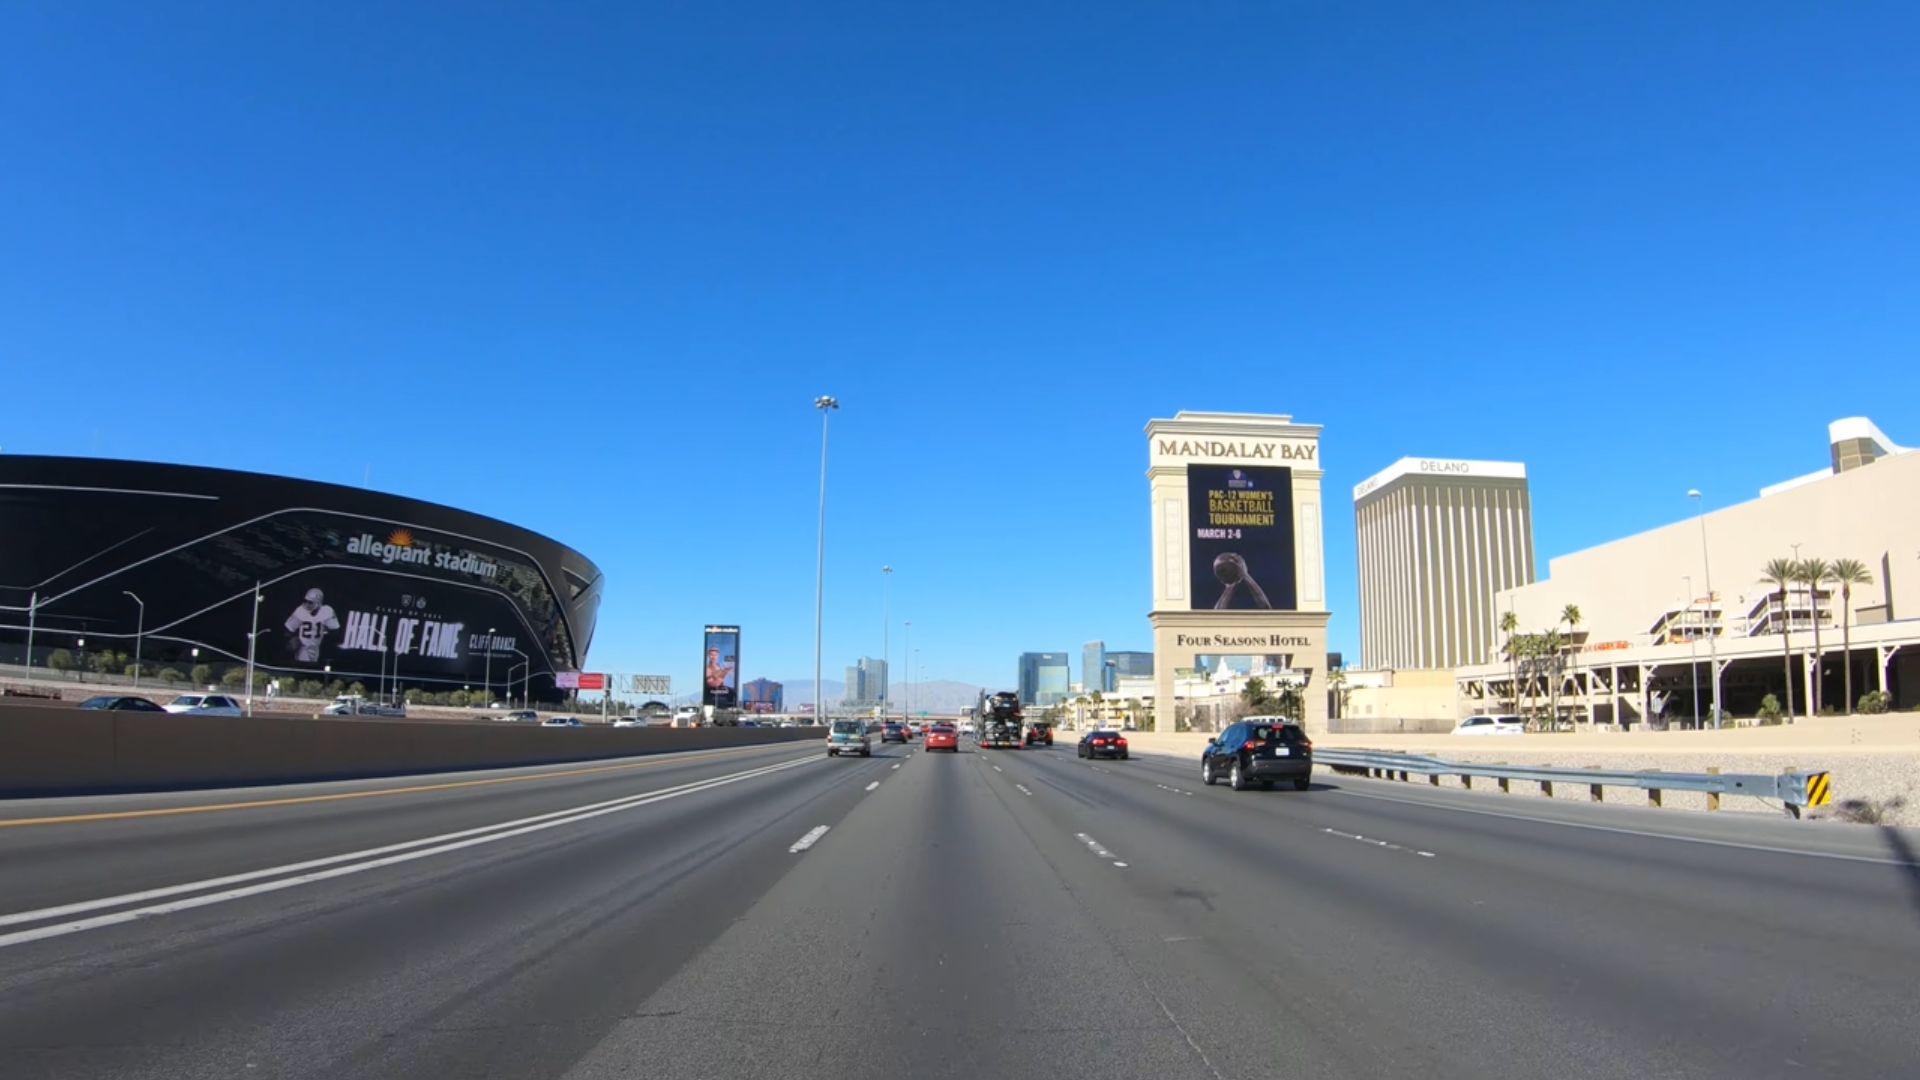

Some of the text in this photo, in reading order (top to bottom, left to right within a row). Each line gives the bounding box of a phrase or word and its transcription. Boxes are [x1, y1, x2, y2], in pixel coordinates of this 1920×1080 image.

[1159, 440, 1316, 460] MANDALAY BAY
[1420, 461, 1469, 473] DELANO
[1209, 490, 1273, 500] PAC-12 WOMEN'S
[1209, 499, 1274, 513] BASKETBALL
[1209, 513, 1274, 526] TOURNAMENT
[1197, 528, 1241, 539] MARCH 2-6
[346, 534, 497, 577] allegiant stadium
[300, 620, 321, 639] 21
[341, 610, 464, 659] HALL OF FAME
[1176, 634, 1311, 646] FOUR SEASONS HOTEL
